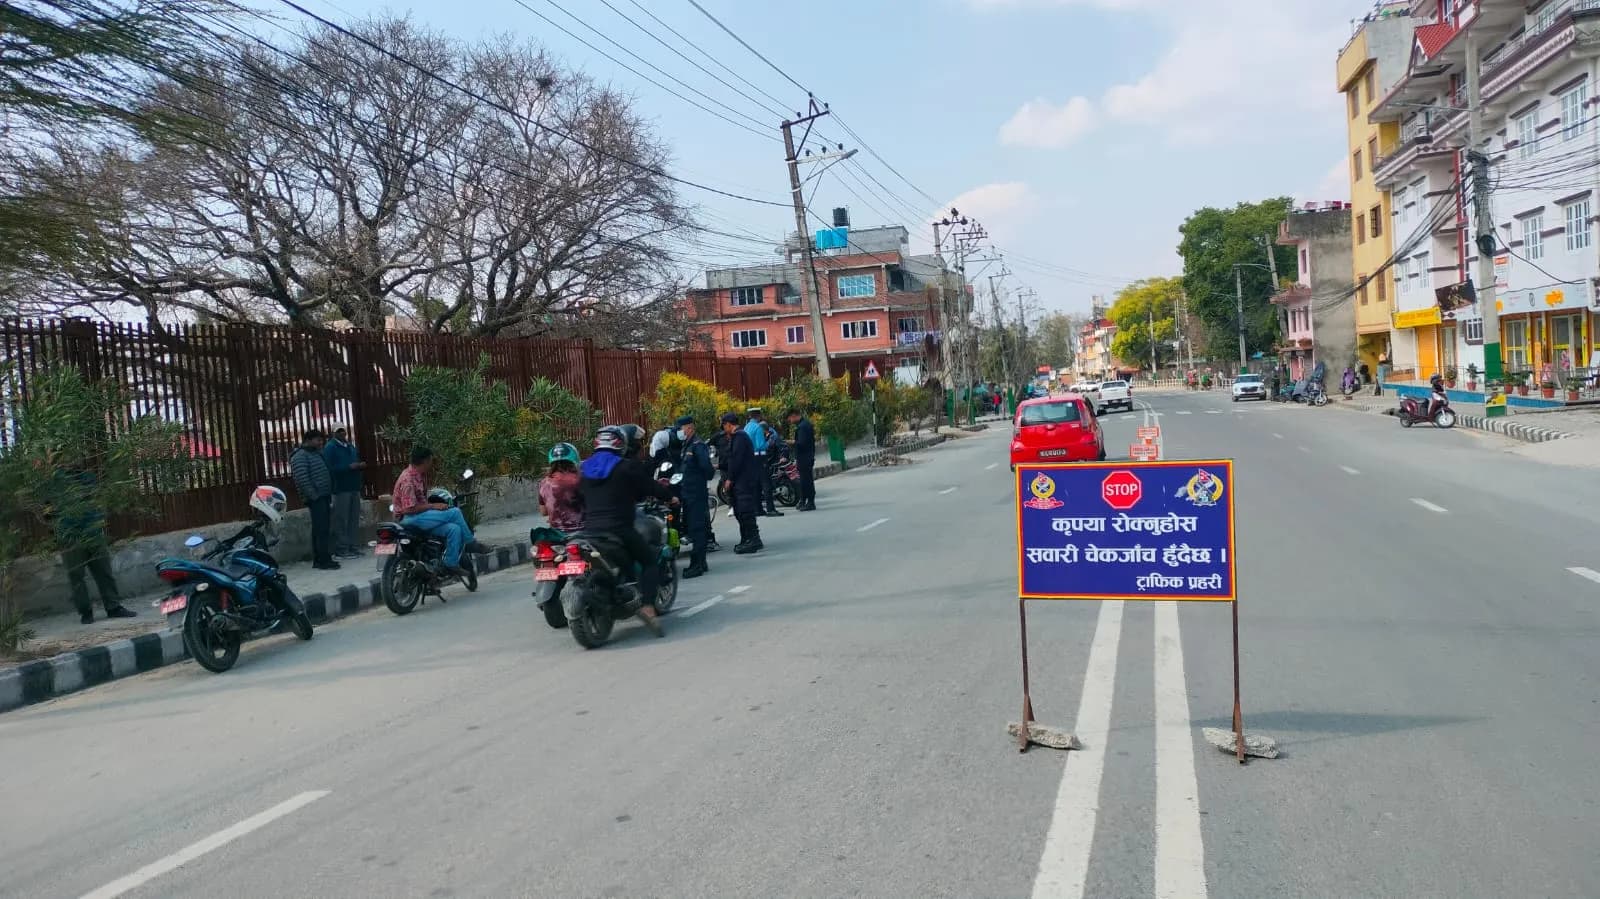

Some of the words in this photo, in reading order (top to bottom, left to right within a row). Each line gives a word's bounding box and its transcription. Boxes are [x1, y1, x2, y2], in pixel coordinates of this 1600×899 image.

[1105, 484, 1138, 496] STOP
[1051, 516, 1107, 537] कृपया
[1111, 511, 1198, 536] रोक्नुहोस
[1026, 543, 1080, 564] सवारी
[1084, 543, 1158, 563] चेकजाँच
[1135, 572, 1185, 592] ट्राफिक
[1187, 573, 1223, 590] प्रहरी
